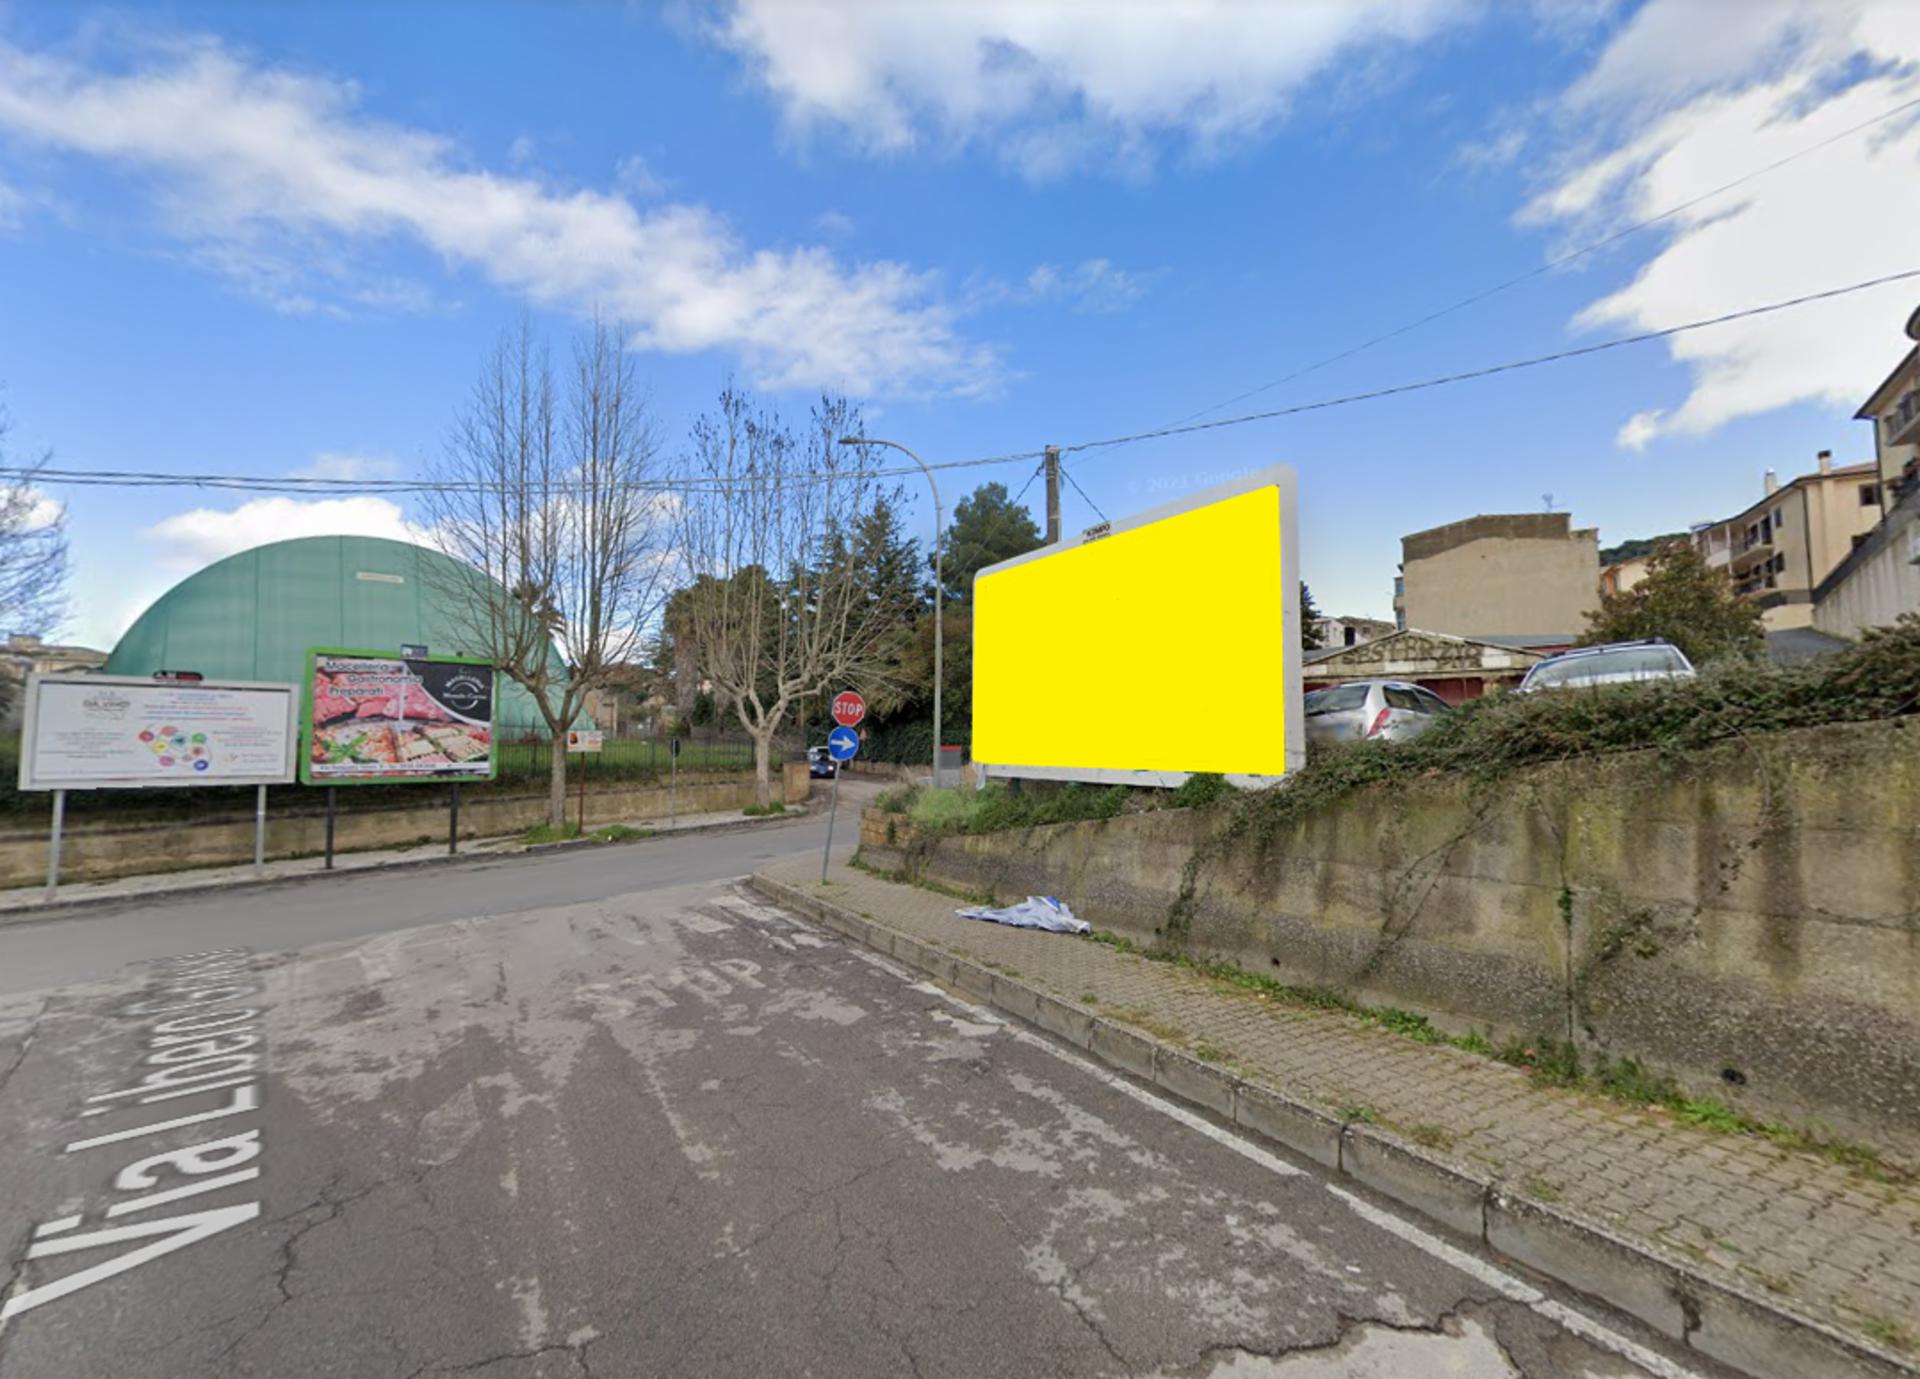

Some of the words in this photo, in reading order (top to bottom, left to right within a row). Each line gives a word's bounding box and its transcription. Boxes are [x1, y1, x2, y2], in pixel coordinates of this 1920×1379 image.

[325, 661, 390, 671] Macelleria
[347, 673, 424, 684] Gastronomia
[329, 686, 384, 698] Preparati
[834, 701, 863, 715] STOP
